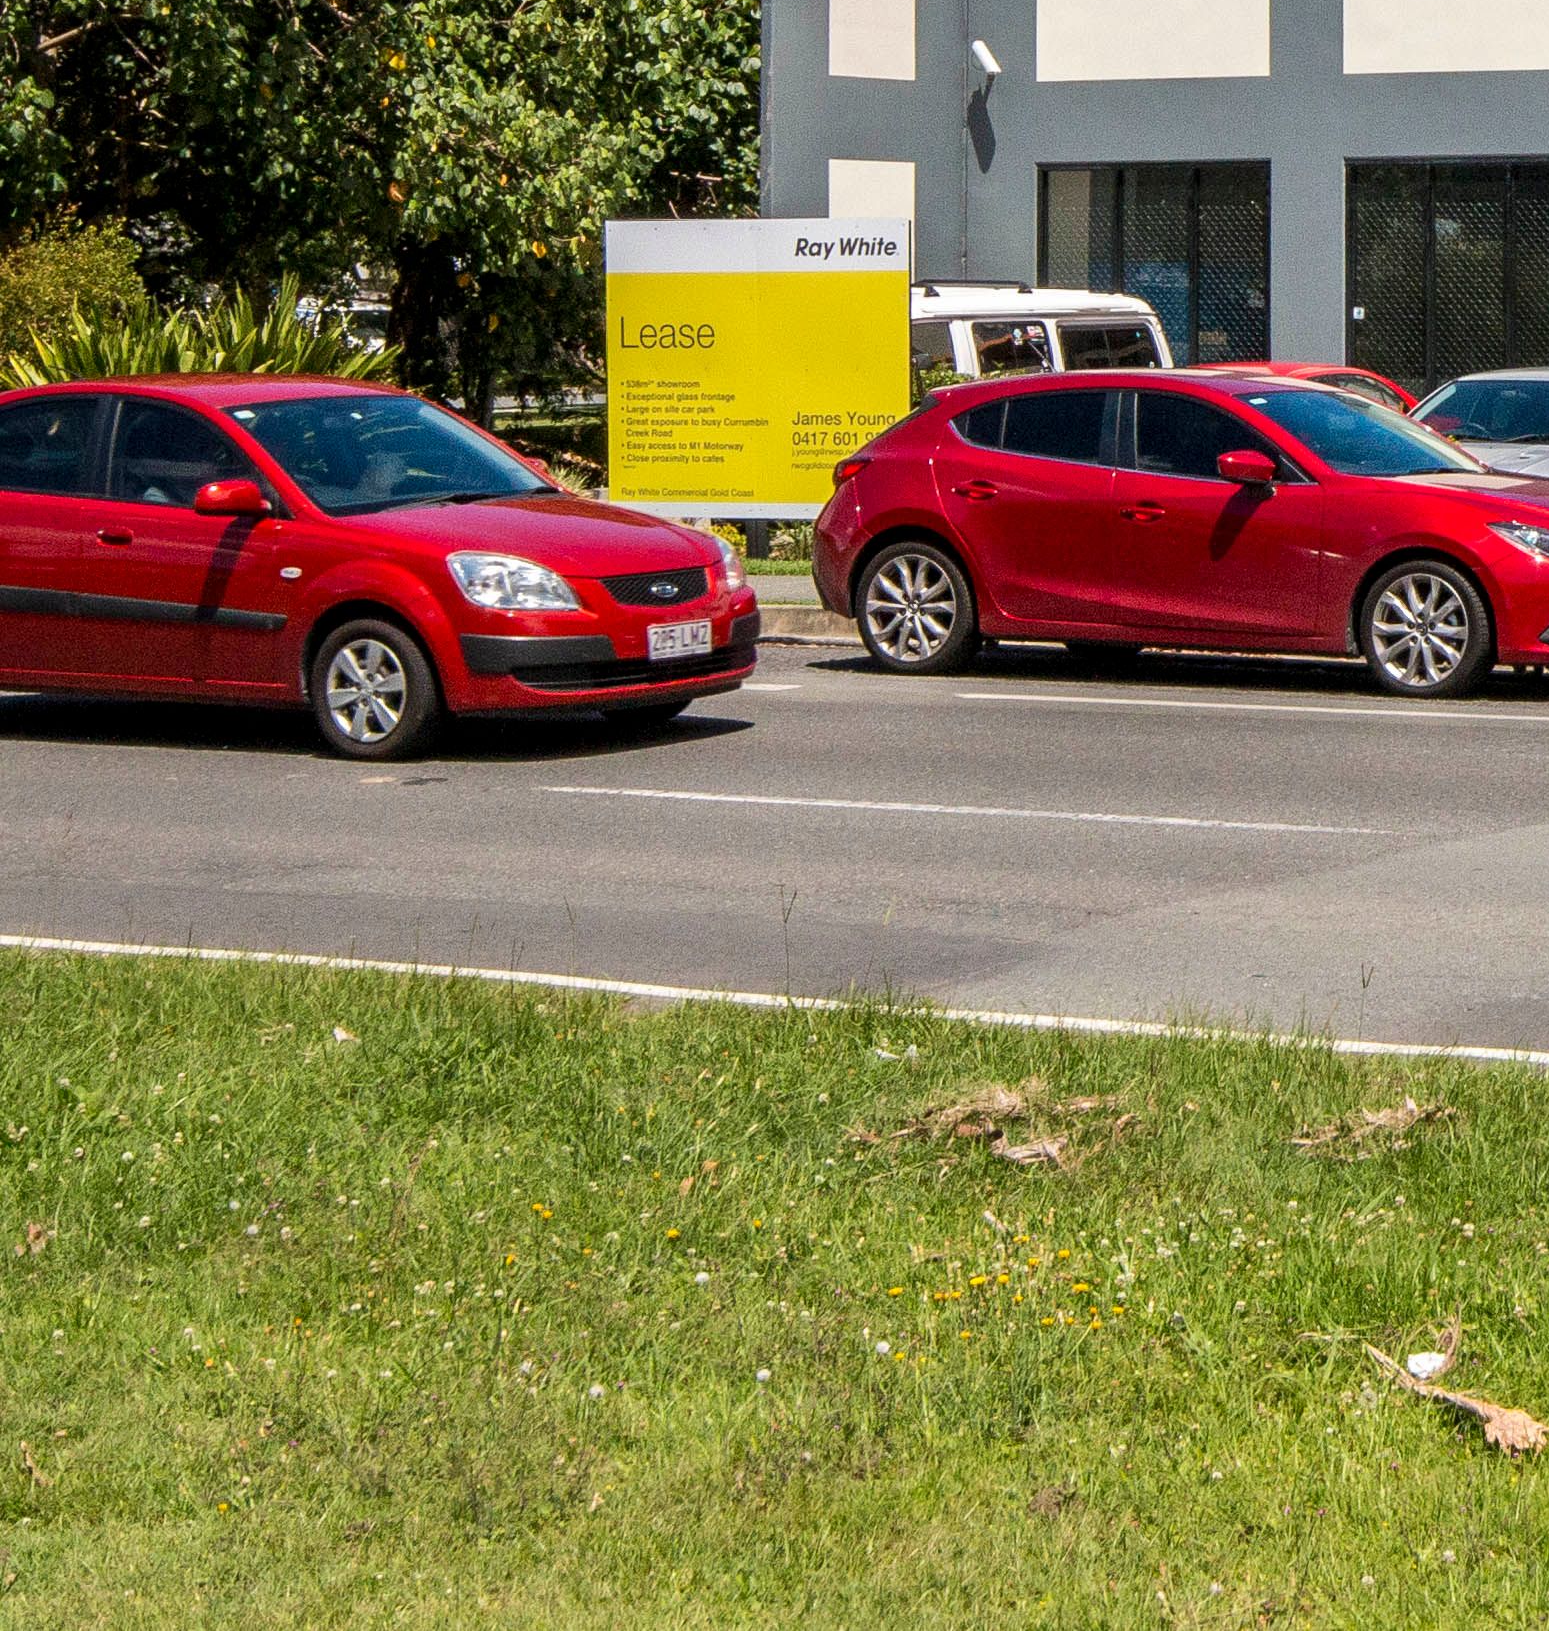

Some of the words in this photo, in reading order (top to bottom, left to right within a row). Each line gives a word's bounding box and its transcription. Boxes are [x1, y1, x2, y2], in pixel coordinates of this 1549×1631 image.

[794, 237, 834, 260] Ray
[839, 236, 897, 257] White
[620, 316, 716, 349] Lease
[657, 380, 700, 388] showroom
[626, 392, 674, 402] Exceptional
[676, 393, 698, 402] glass
[701, 392, 736, 403] frontage
[626, 405, 650, 415] Large
[652, 406, 663, 414] on
[665, 405, 680, 414] site
[681, 406, 695, 414] car
[697, 405, 715, 415] park
[626, 417, 649, 426] Great
[651, 418, 689, 428] exposure
[691, 417, 699, 426] to
[701, 417, 721, 428] busy
[724, 417, 769, 427] Currumbin
[792, 411, 842, 426] James
[847, 411, 896, 427] Young
[626, 429, 650, 437] Creek
[651, 429, 673, 437] Road
[792, 431, 828, 446] 0417
[833, 431, 858, 446] 601
[627, 441, 646, 451] Easy
[679, 441, 687, 450] to
[689, 441, 701, 450] M1
[703, 441, 744, 451] Motorway
[627, 453, 650, 462] Close
[652, 453, 689, 464] proximity
[692, 453, 700, 462] to
[621, 487, 636, 498] Ray
[638, 487, 660, 496] White
[662, 487, 708, 496] Commercial
[710, 487, 729, 497] Gold
[731, 488, 754, 497] Coast
